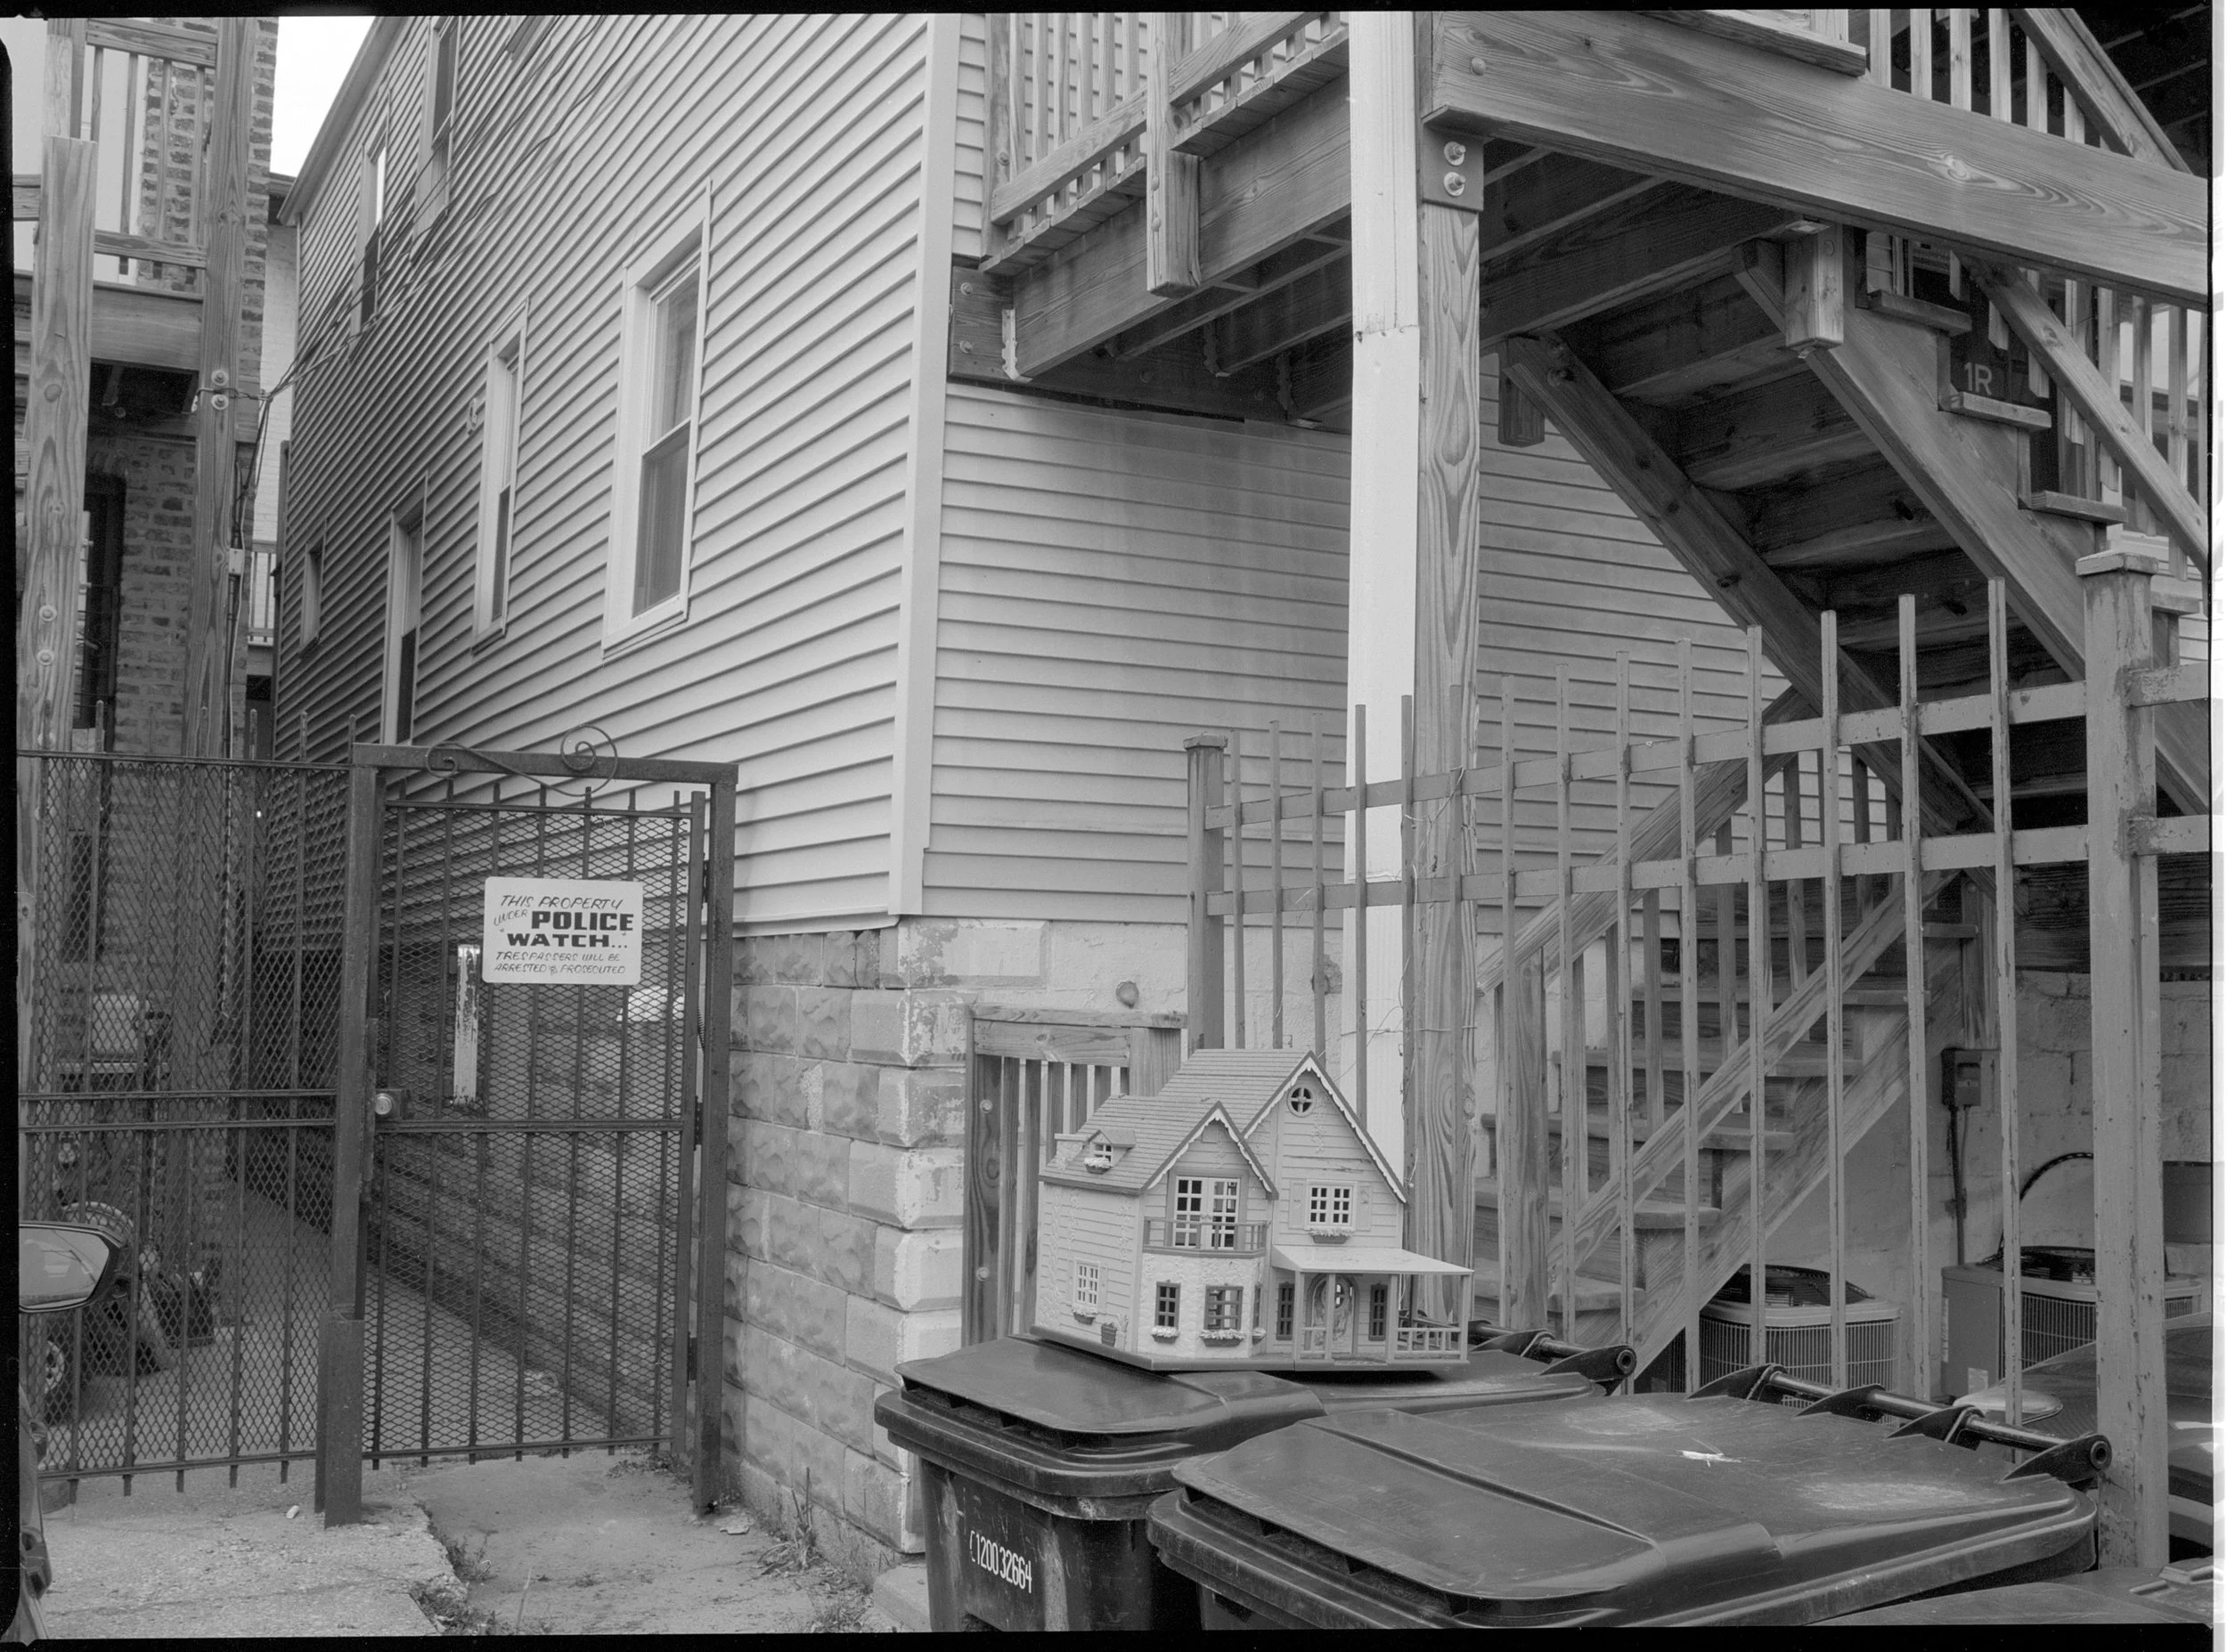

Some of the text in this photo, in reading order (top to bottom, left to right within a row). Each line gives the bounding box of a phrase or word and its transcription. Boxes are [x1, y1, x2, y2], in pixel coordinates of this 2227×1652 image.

[1964, 362, 1993, 395] 1R
[501, 895, 624, 909] THIS PROPERTY
[494, 909, 527, 926] UNDER
[531, 911, 634, 931] POLICE
[495, 951, 621, 962] TRESPASSERS WILL BE
[494, 964, 548, 973] ARRESTED
[560, 964, 625, 974] PROSECUTED
